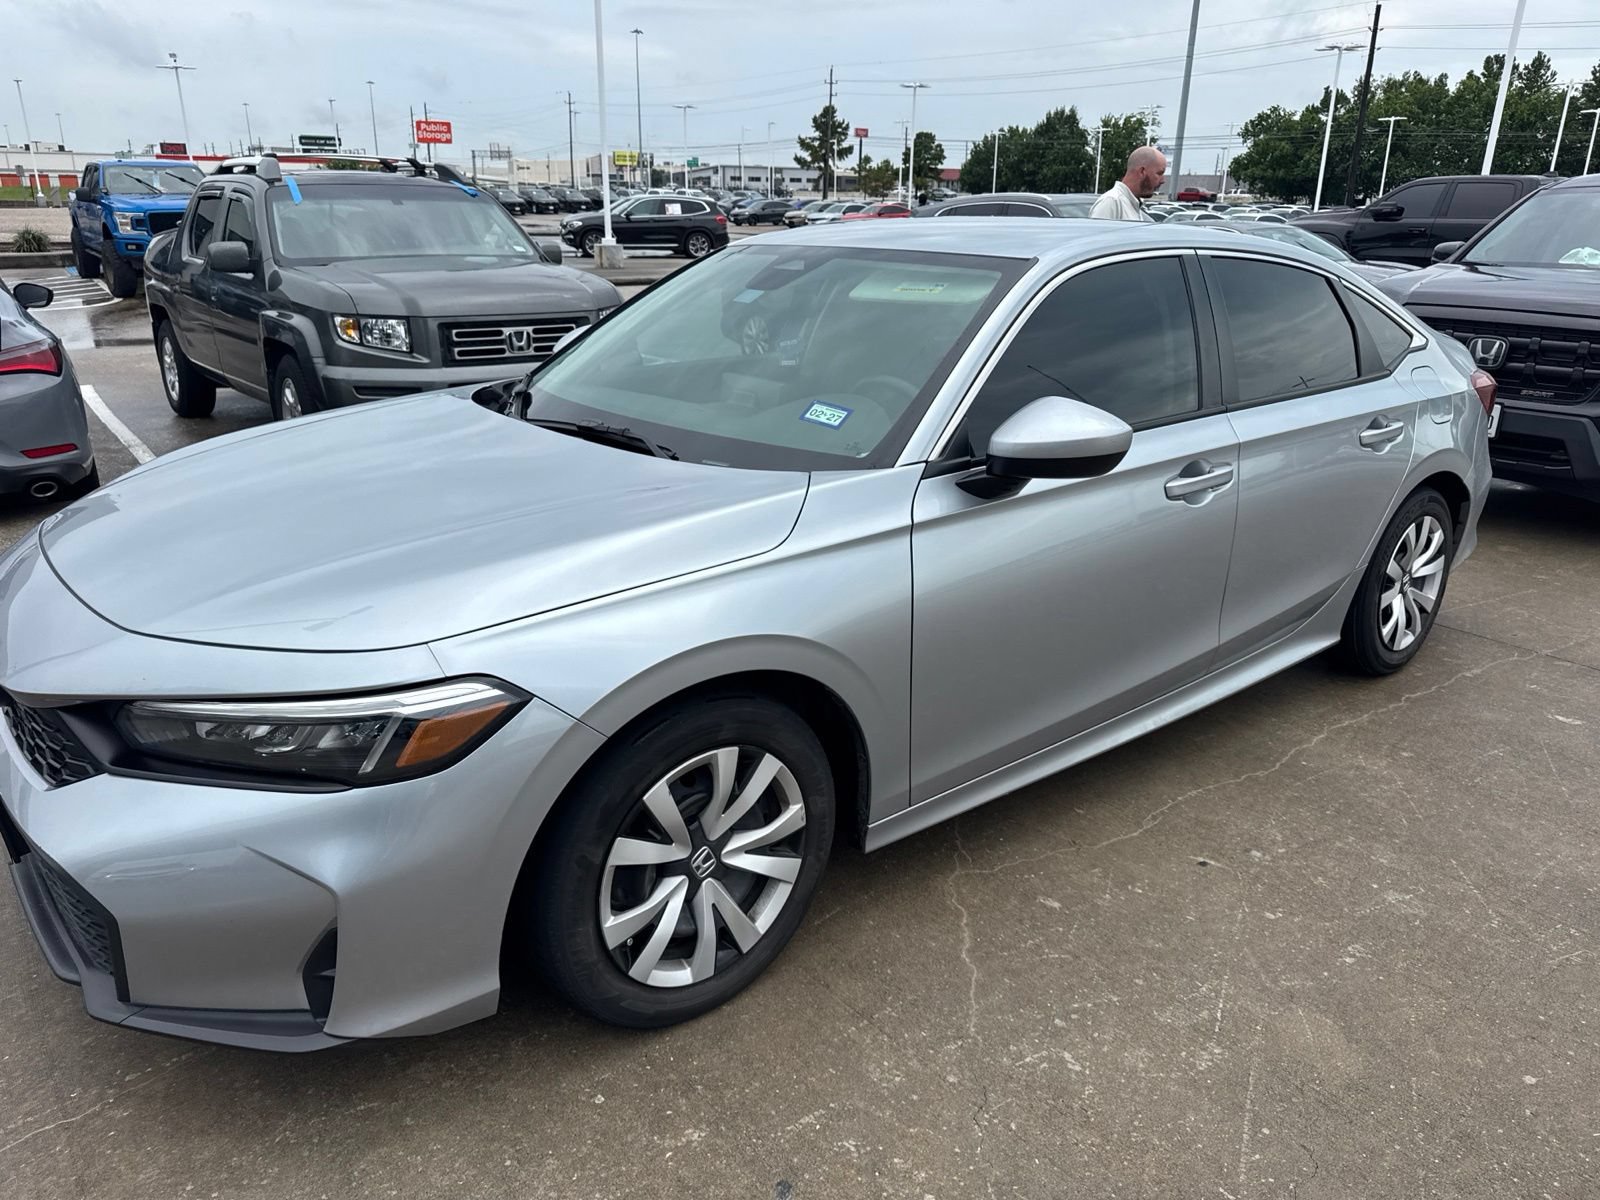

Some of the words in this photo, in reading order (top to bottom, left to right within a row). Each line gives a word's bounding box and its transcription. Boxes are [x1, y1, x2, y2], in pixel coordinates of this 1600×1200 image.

[420, 122, 448, 132] Public
[418, 130, 451, 142] Storage
[1519, 389, 1554, 397] SPORT
